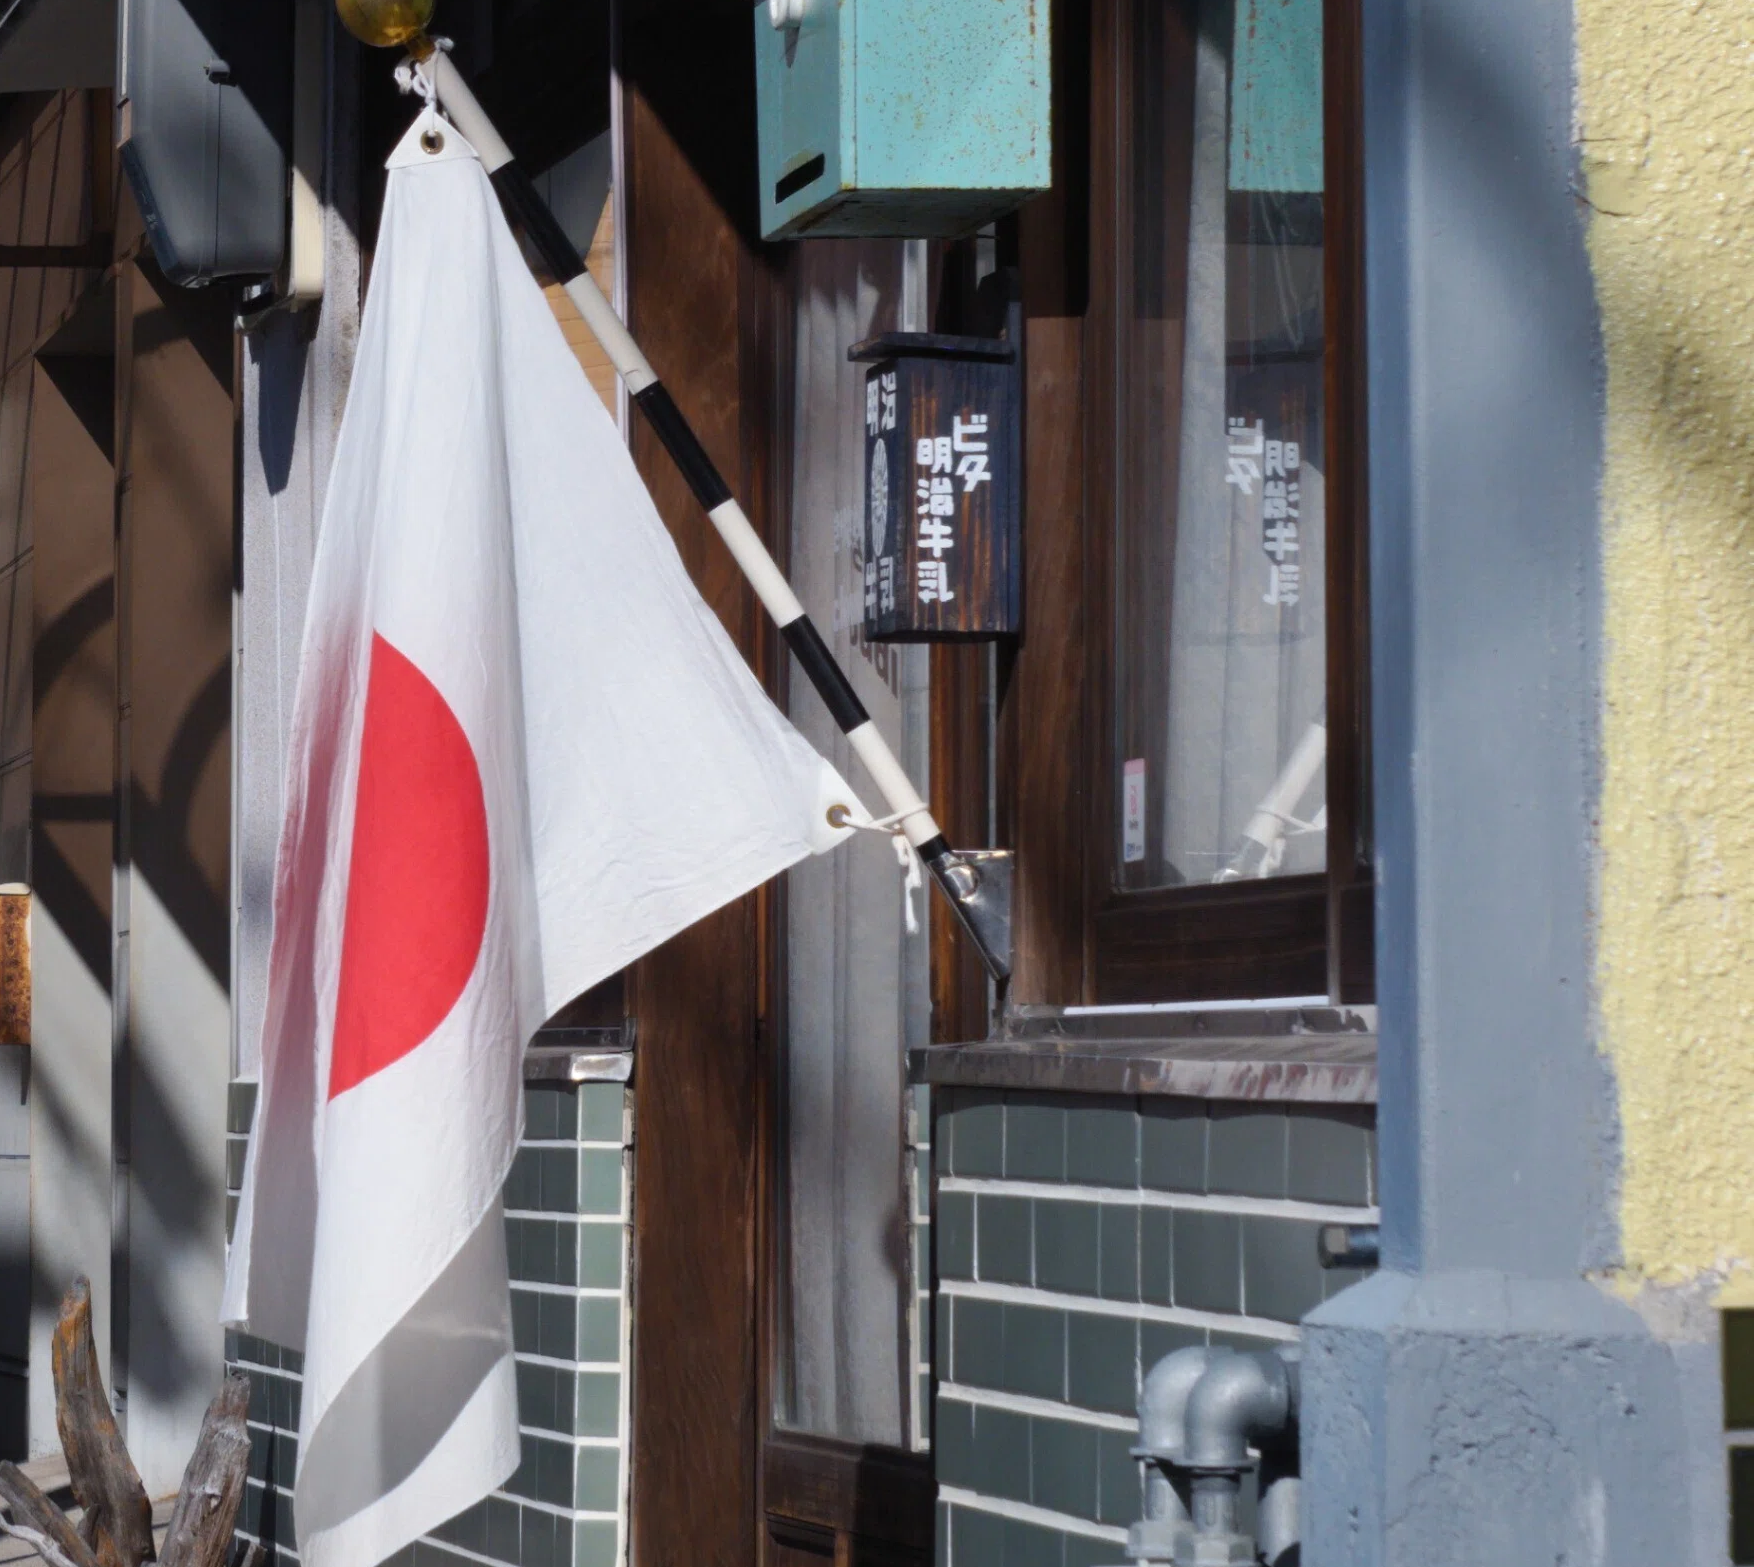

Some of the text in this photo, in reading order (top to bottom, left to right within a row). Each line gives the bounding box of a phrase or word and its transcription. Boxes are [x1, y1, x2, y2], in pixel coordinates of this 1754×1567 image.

[952, 414, 993, 492] ビタ
[916, 437, 954, 603] 明治牛乳
